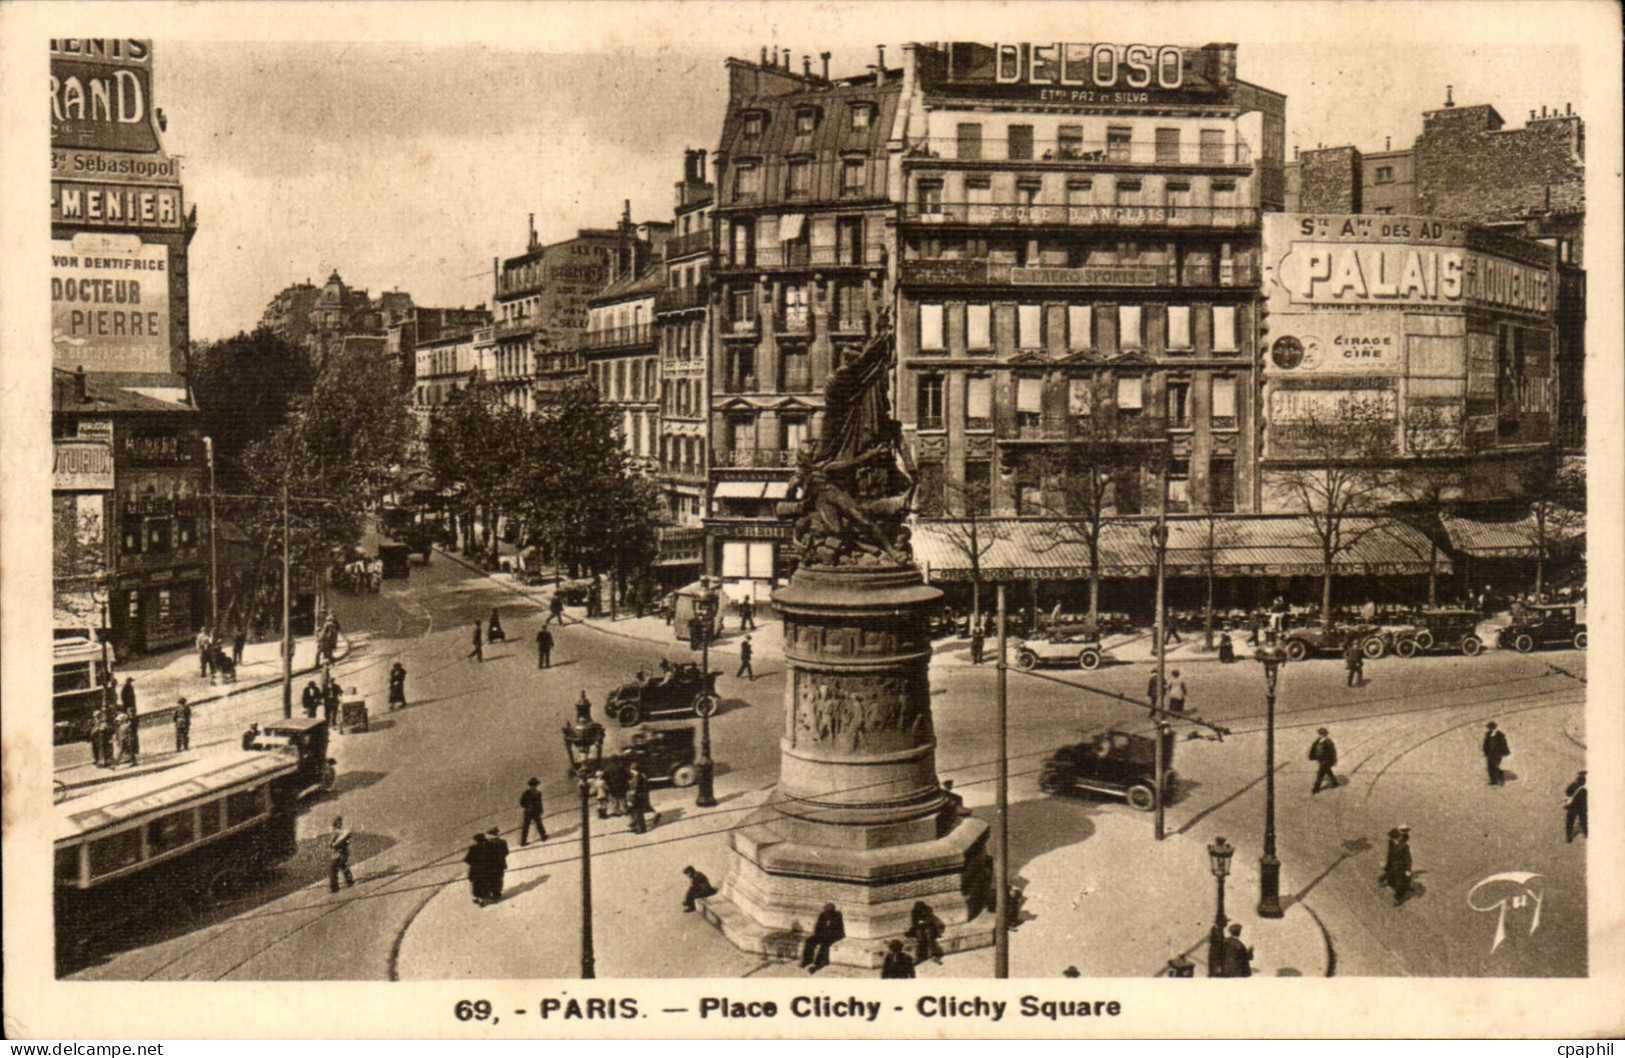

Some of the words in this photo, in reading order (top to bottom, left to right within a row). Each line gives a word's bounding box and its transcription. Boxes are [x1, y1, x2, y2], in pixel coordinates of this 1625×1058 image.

[995, 43, 1184, 89] DELOSO
[1071, 91, 1095, 102] PAZ
[1114, 92, 1148, 103] SILVA
[73, 154, 175, 176] Sébastopol
[1382, 225, 1412, 238] DES
[84, 257, 166, 271] DENTIFRICE
[1299, 252, 1464, 300] PALAIS
[51, 277, 142, 305] DOCTEUR
[71, 310, 160, 336] PIERRE
[1334, 335, 1392, 346] CIRAGE
[1343, 350, 1382, 358] CIRE
